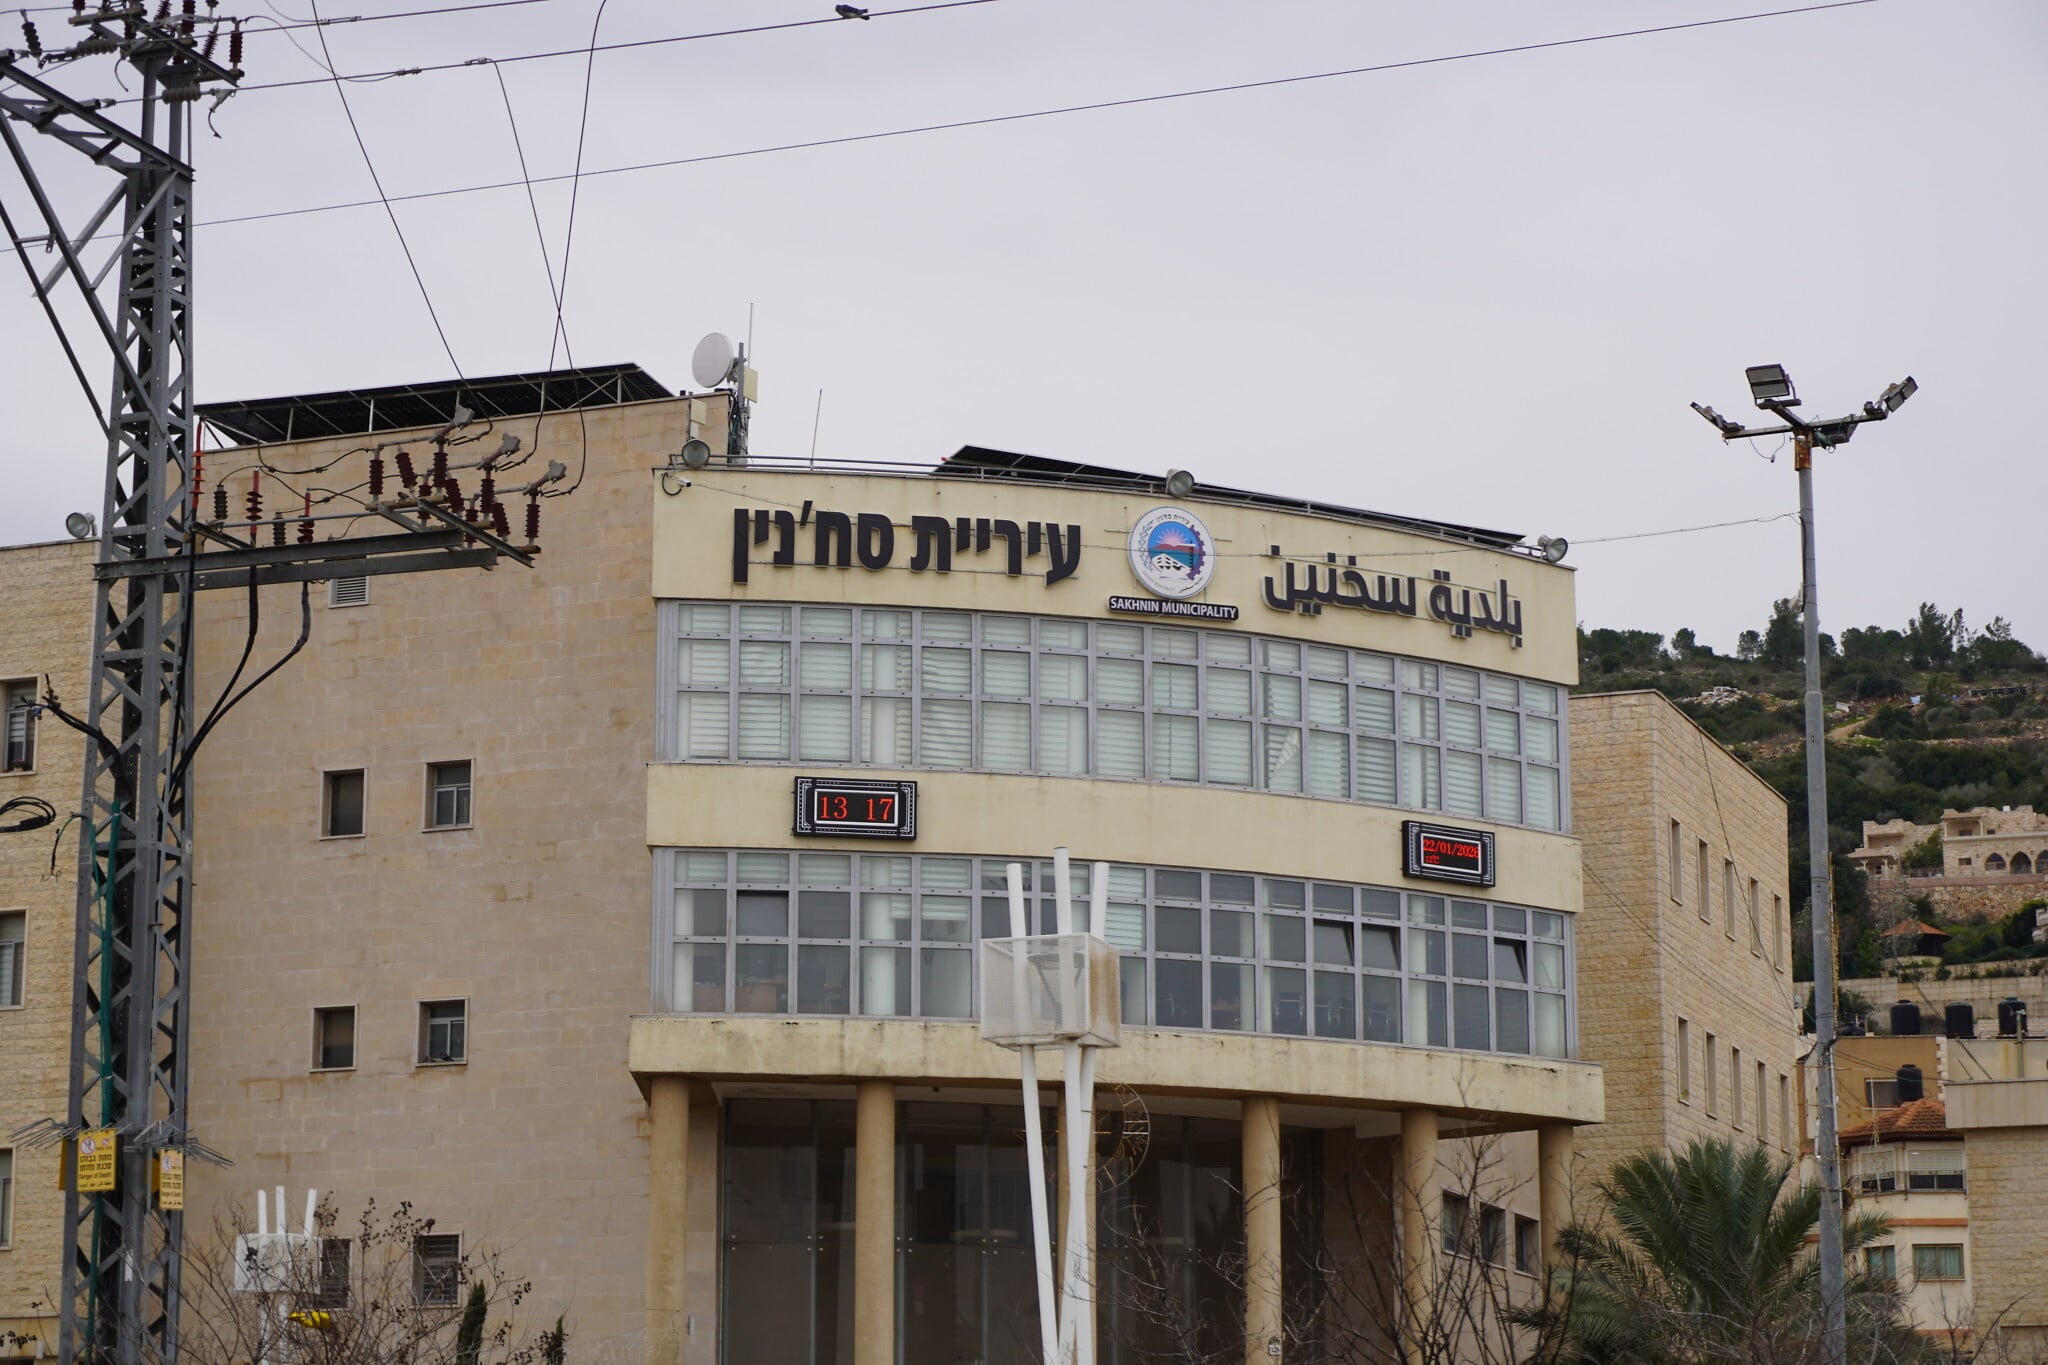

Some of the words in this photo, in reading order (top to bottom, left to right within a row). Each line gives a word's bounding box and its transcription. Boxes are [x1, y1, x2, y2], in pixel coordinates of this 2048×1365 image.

[910, 515, 1081, 587] עיריית
[1263, 545, 1416, 616] سخنين
[1110, 598, 1159, 612] SAKHNIN
[1161, 602, 1237, 618] MUNICIPALITY
[1428, 569, 1522, 649] بلدية
[820, 796, 848, 819] 13
[866, 798, 893, 820] 17
